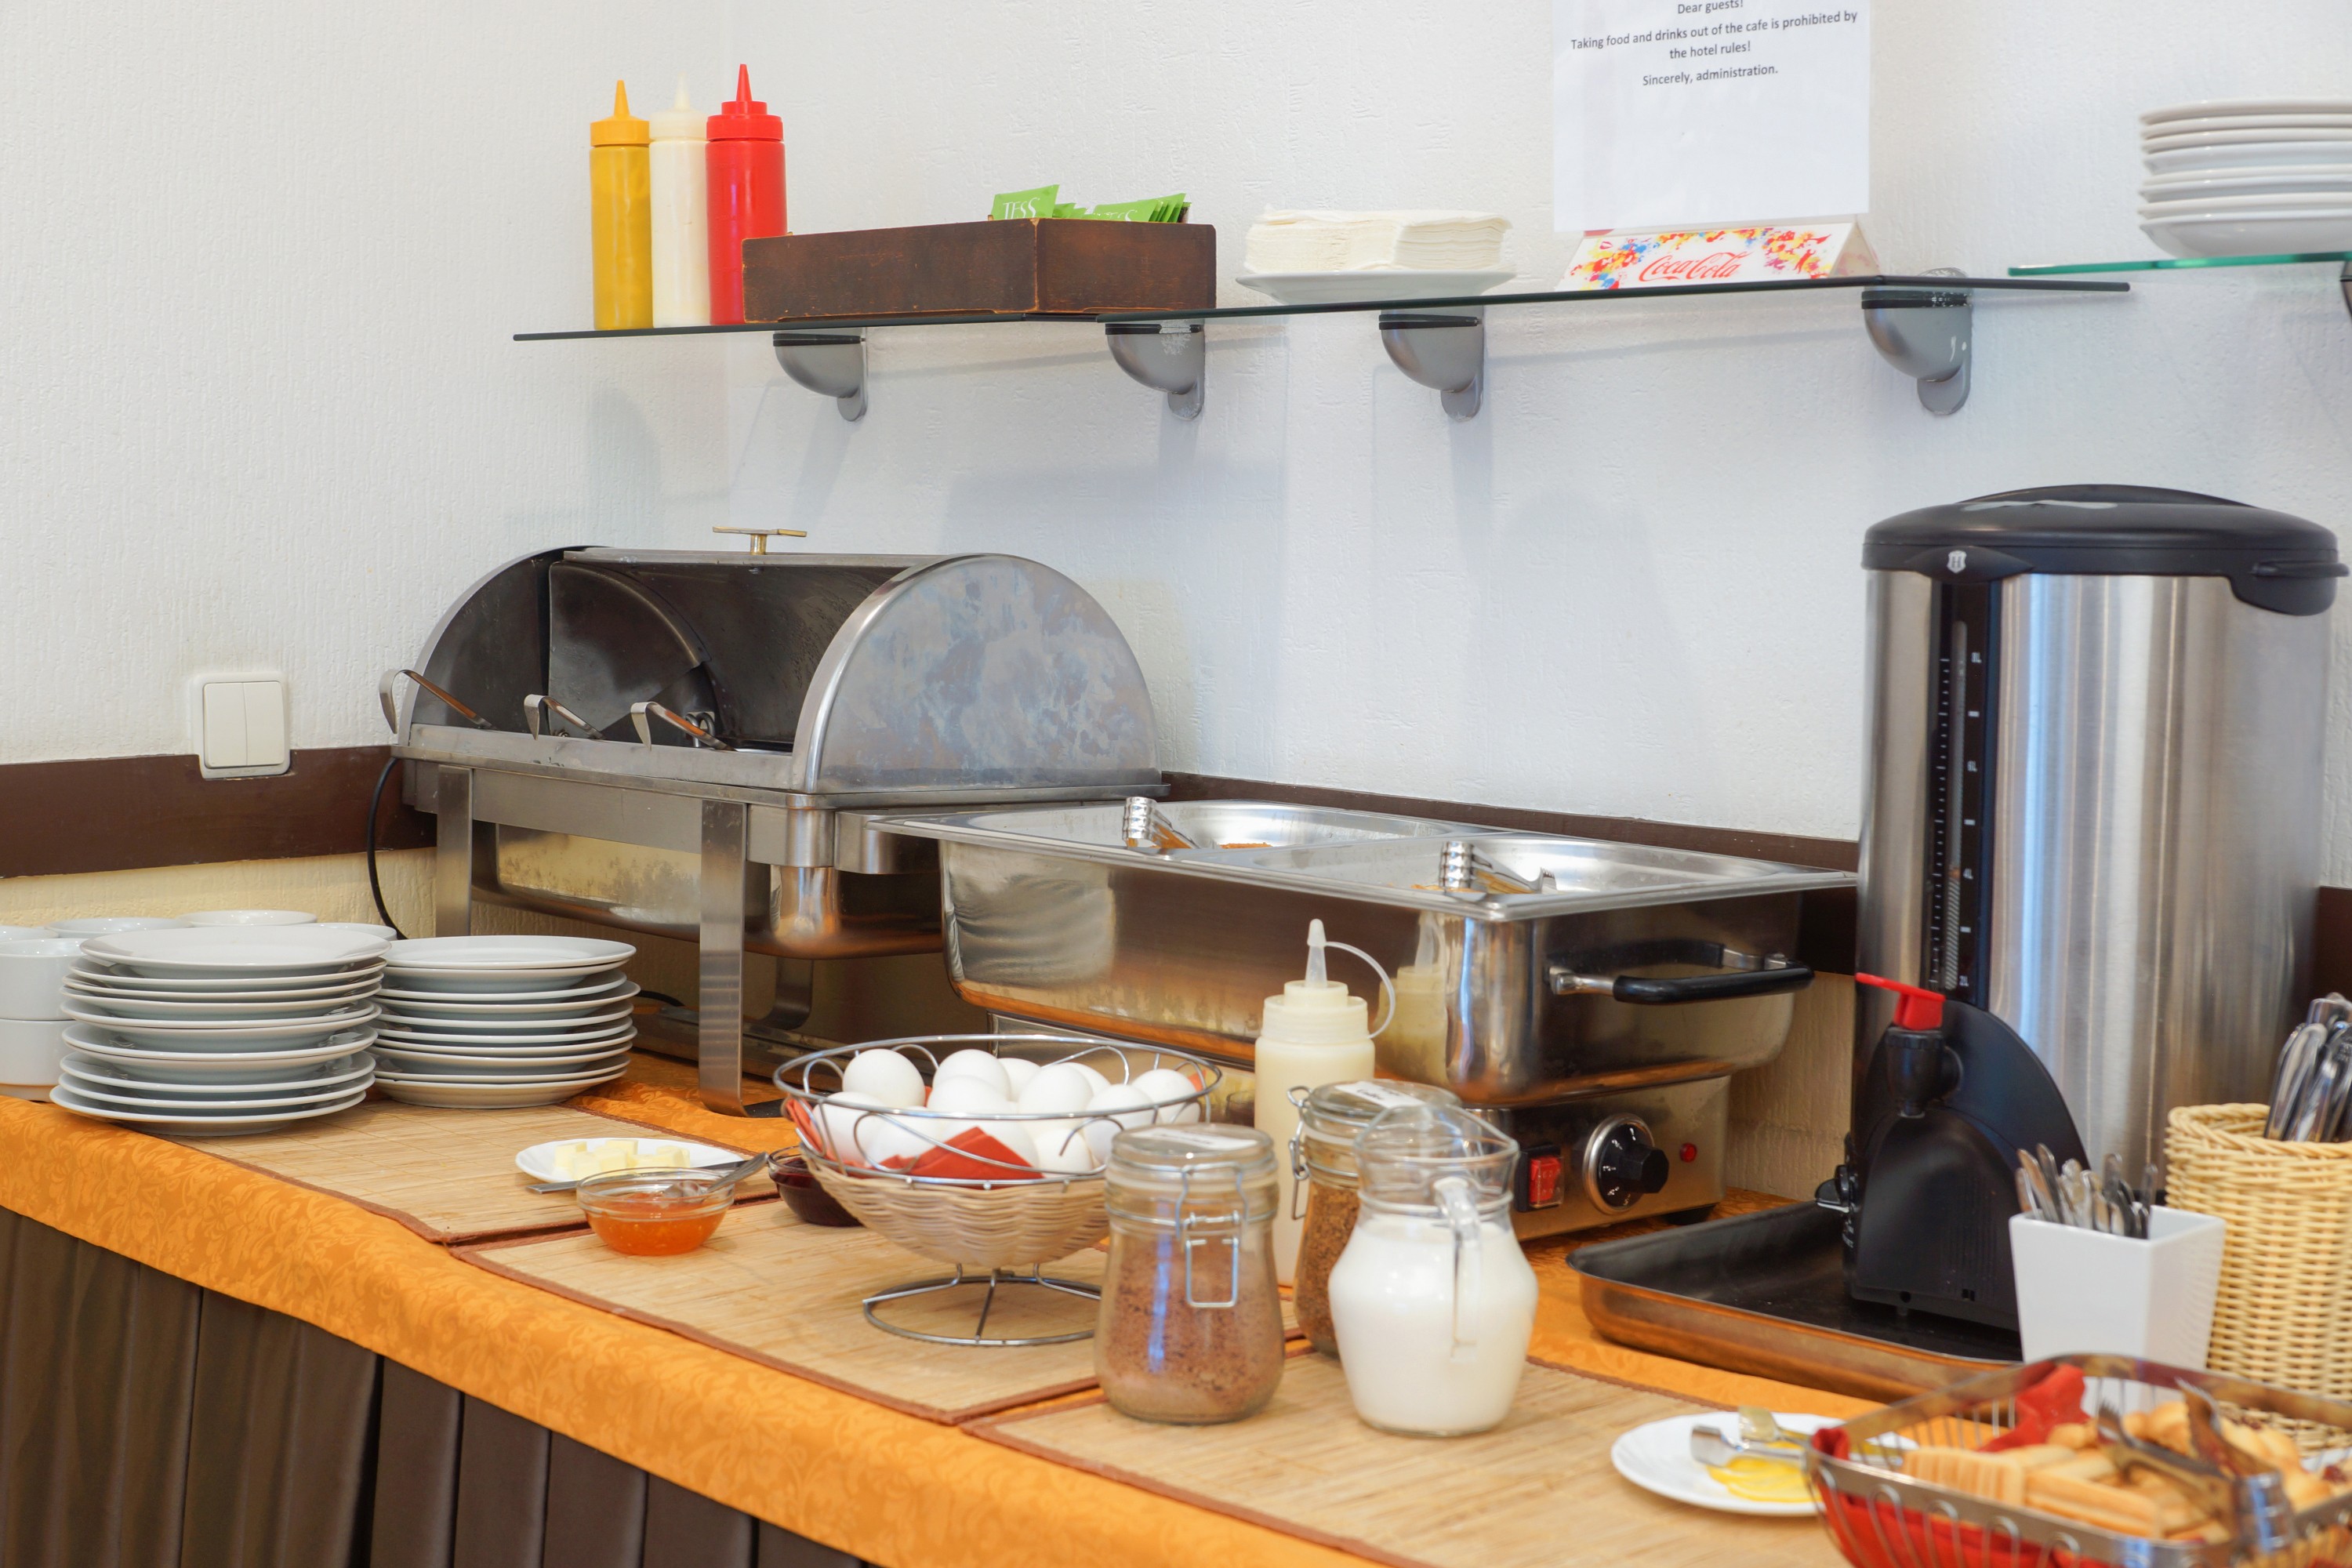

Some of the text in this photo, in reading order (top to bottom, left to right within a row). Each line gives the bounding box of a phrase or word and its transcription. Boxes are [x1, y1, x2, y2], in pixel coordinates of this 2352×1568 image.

[1677, 0, 1744, 14] Dear guests!
[1570, 10, 1858, 49] Taking food and drinks out of the cafe is prohibited by
[1669, 40, 1751, 60] the hotel rules!
[1642, 64, 1779, 86] Sincerely, administration.
